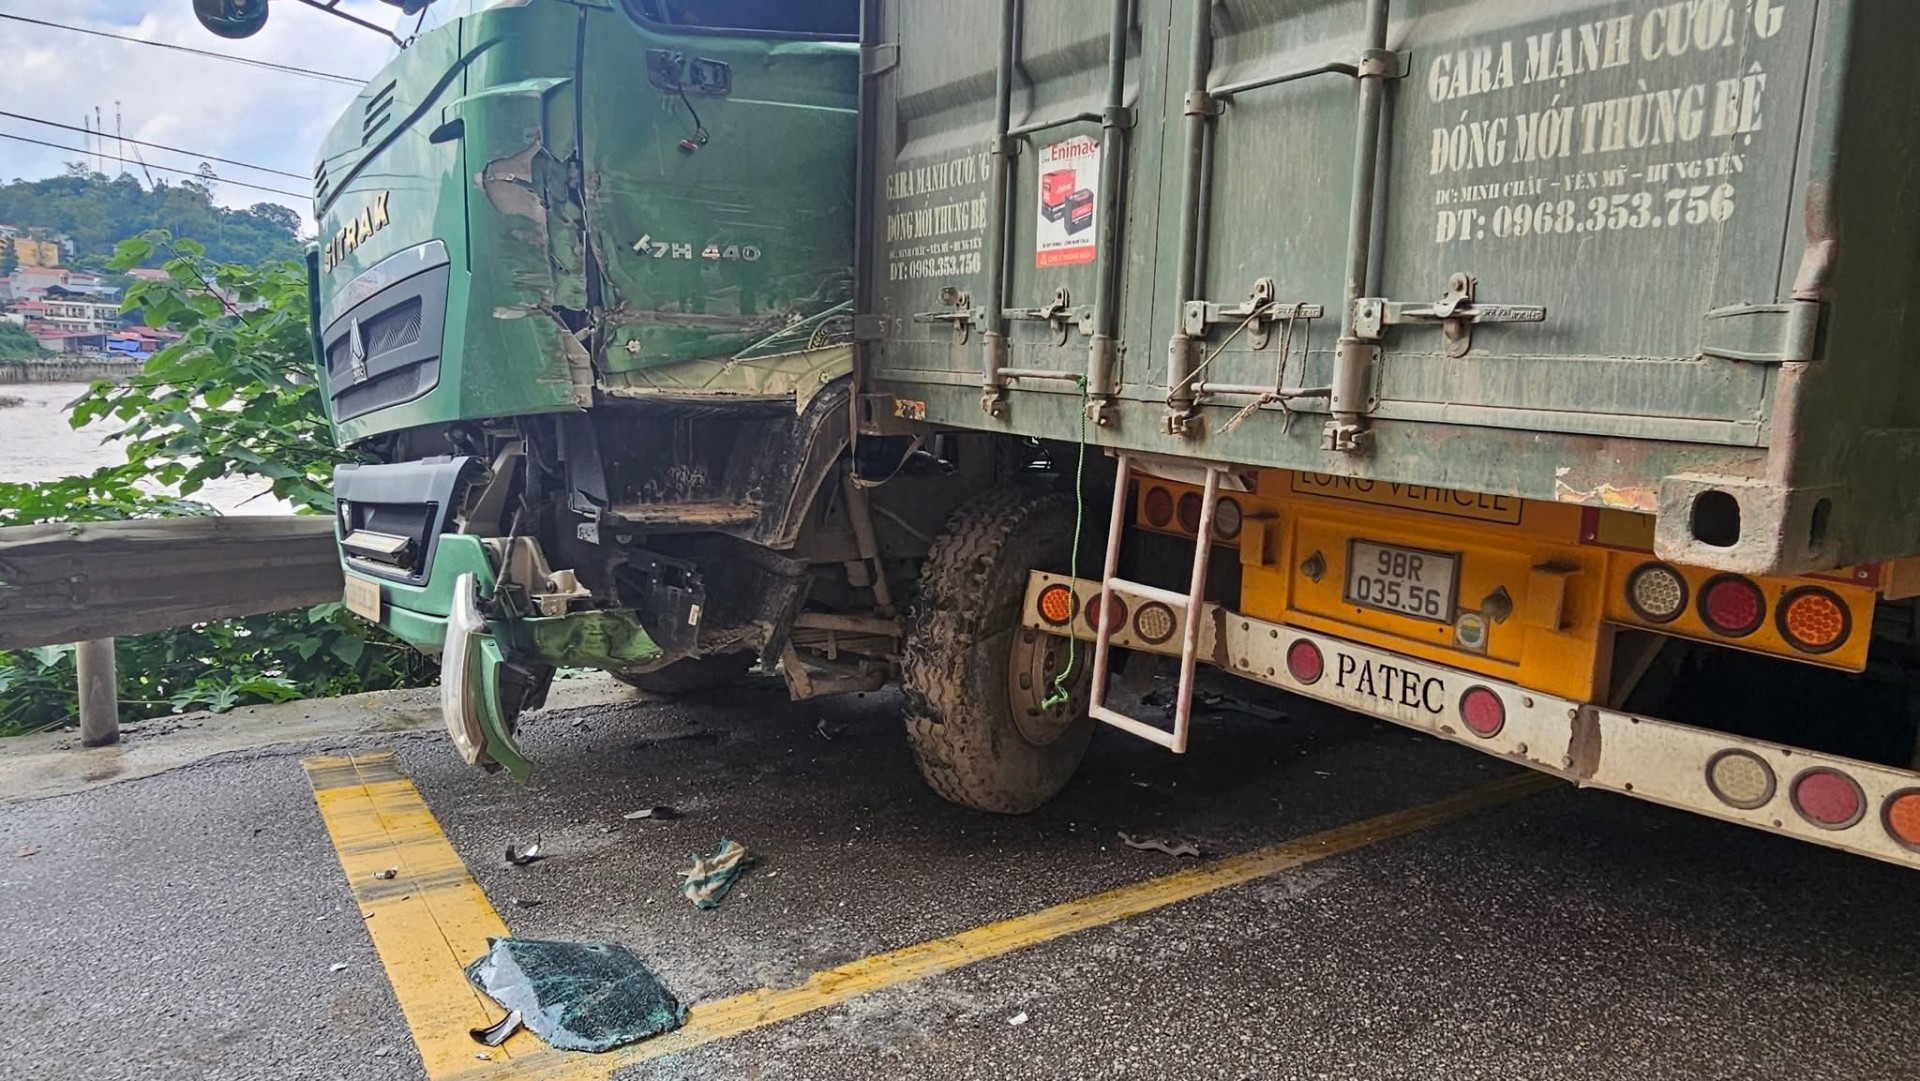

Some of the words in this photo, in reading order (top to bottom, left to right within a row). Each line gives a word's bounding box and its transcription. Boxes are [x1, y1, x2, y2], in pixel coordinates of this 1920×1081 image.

[1428, 41, 1514, 103] GARA
[1523, 14, 1634, 87] MẠNH
[1429, 110, 1508, 175] ĐÓNG
[1512, 95, 1575, 164] MỚI
[1581, 78, 1706, 155] THÙNG
[886, 169, 914, 200] GARA
[916, 162, 948, 199] MẠNH
[1460, 183, 1500, 202] MINH
[1565, 170, 1598, 192] YÊN
[934, 195, 969, 235] THÙNG
[1492, 183, 1735, 238] 0968.353.756
[324, 190, 390, 274] SITRAK
[702, 244, 761, 261] 440
[1377, 550, 1423, 582] 98R
[1357, 575, 1441, 616] 035.56
[1335, 652, 1446, 714] PATEC
